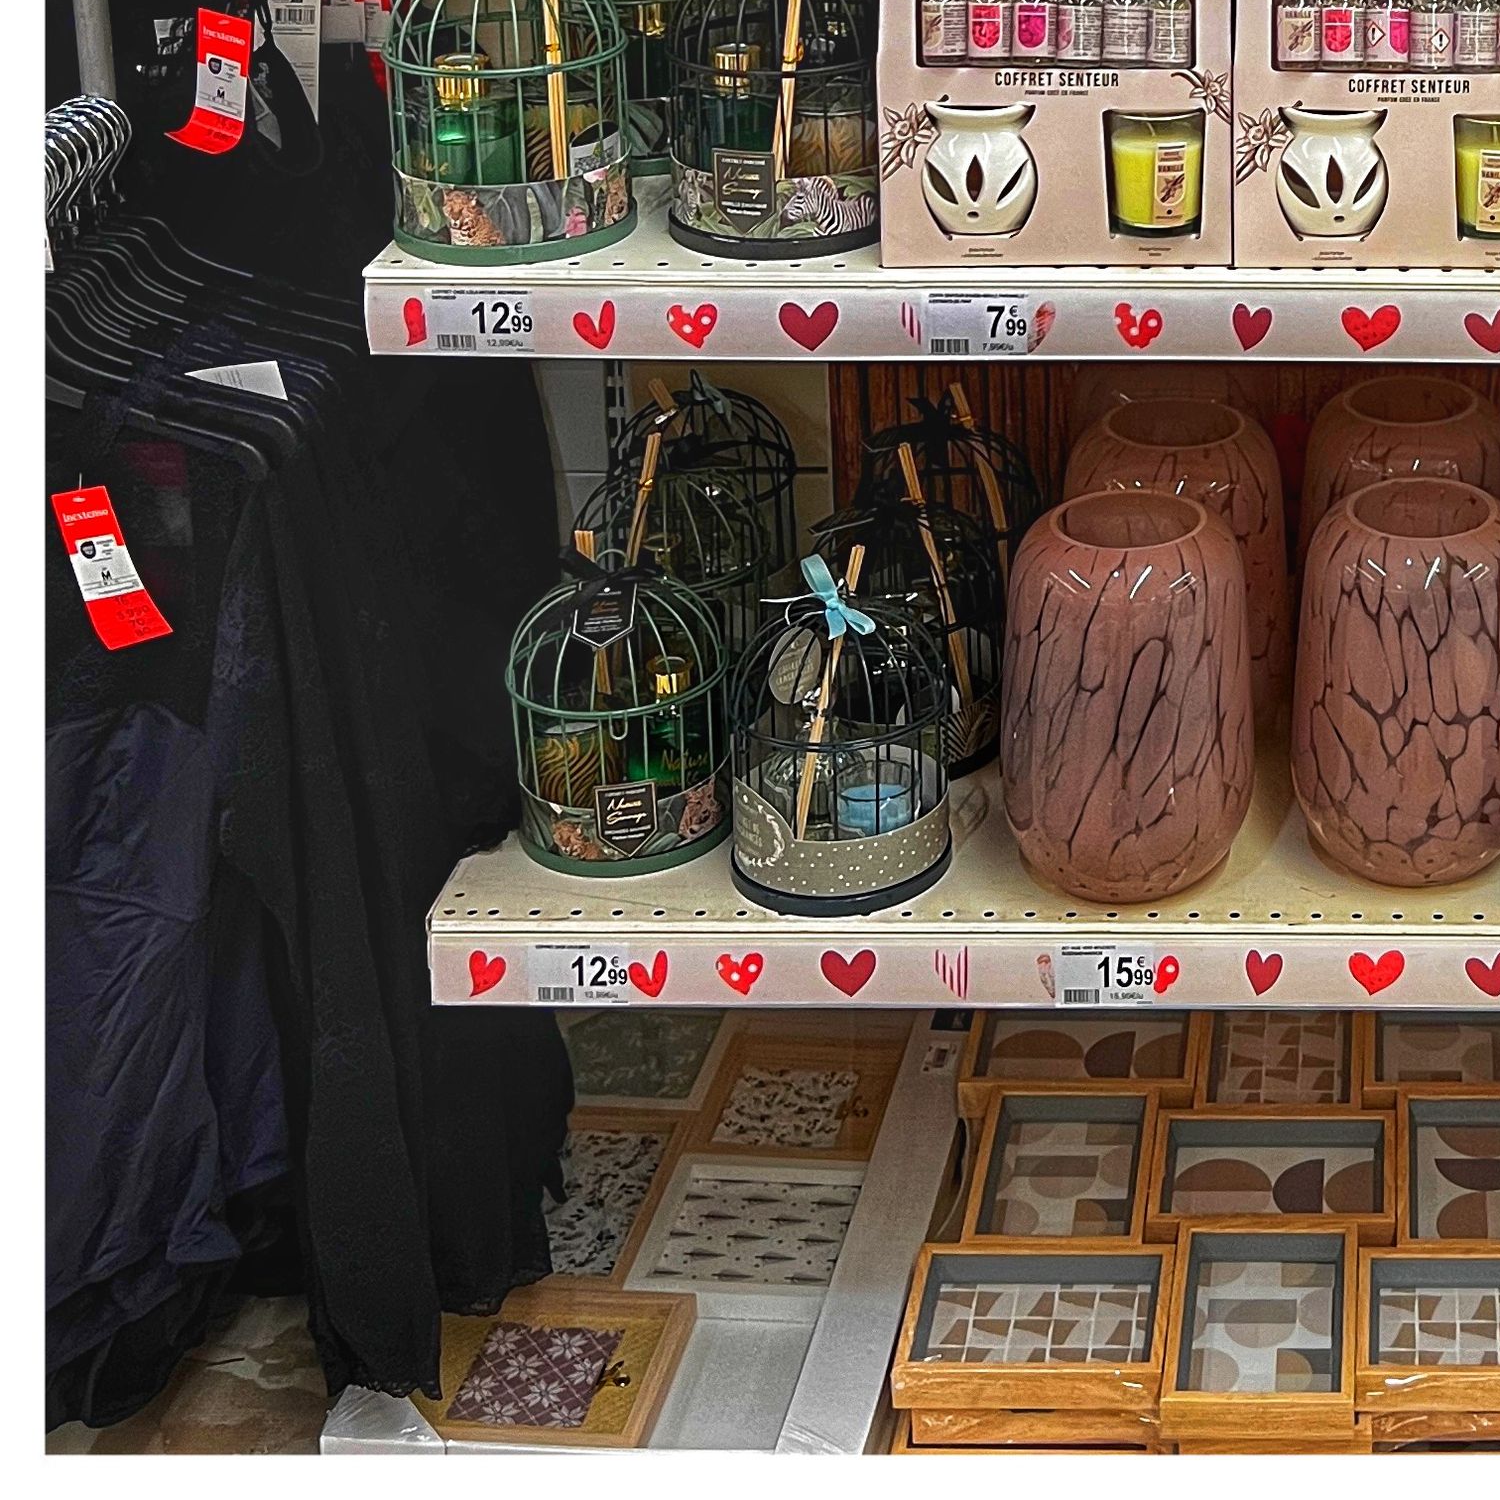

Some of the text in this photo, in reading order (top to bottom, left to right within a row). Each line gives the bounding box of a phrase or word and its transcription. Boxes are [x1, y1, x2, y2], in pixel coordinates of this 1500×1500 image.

[995, 71, 1119, 87] COFFRET SENTEUR
[1348, 78, 1471, 94] COFFRET SENTEUR
[101, 570, 113, 580] M
